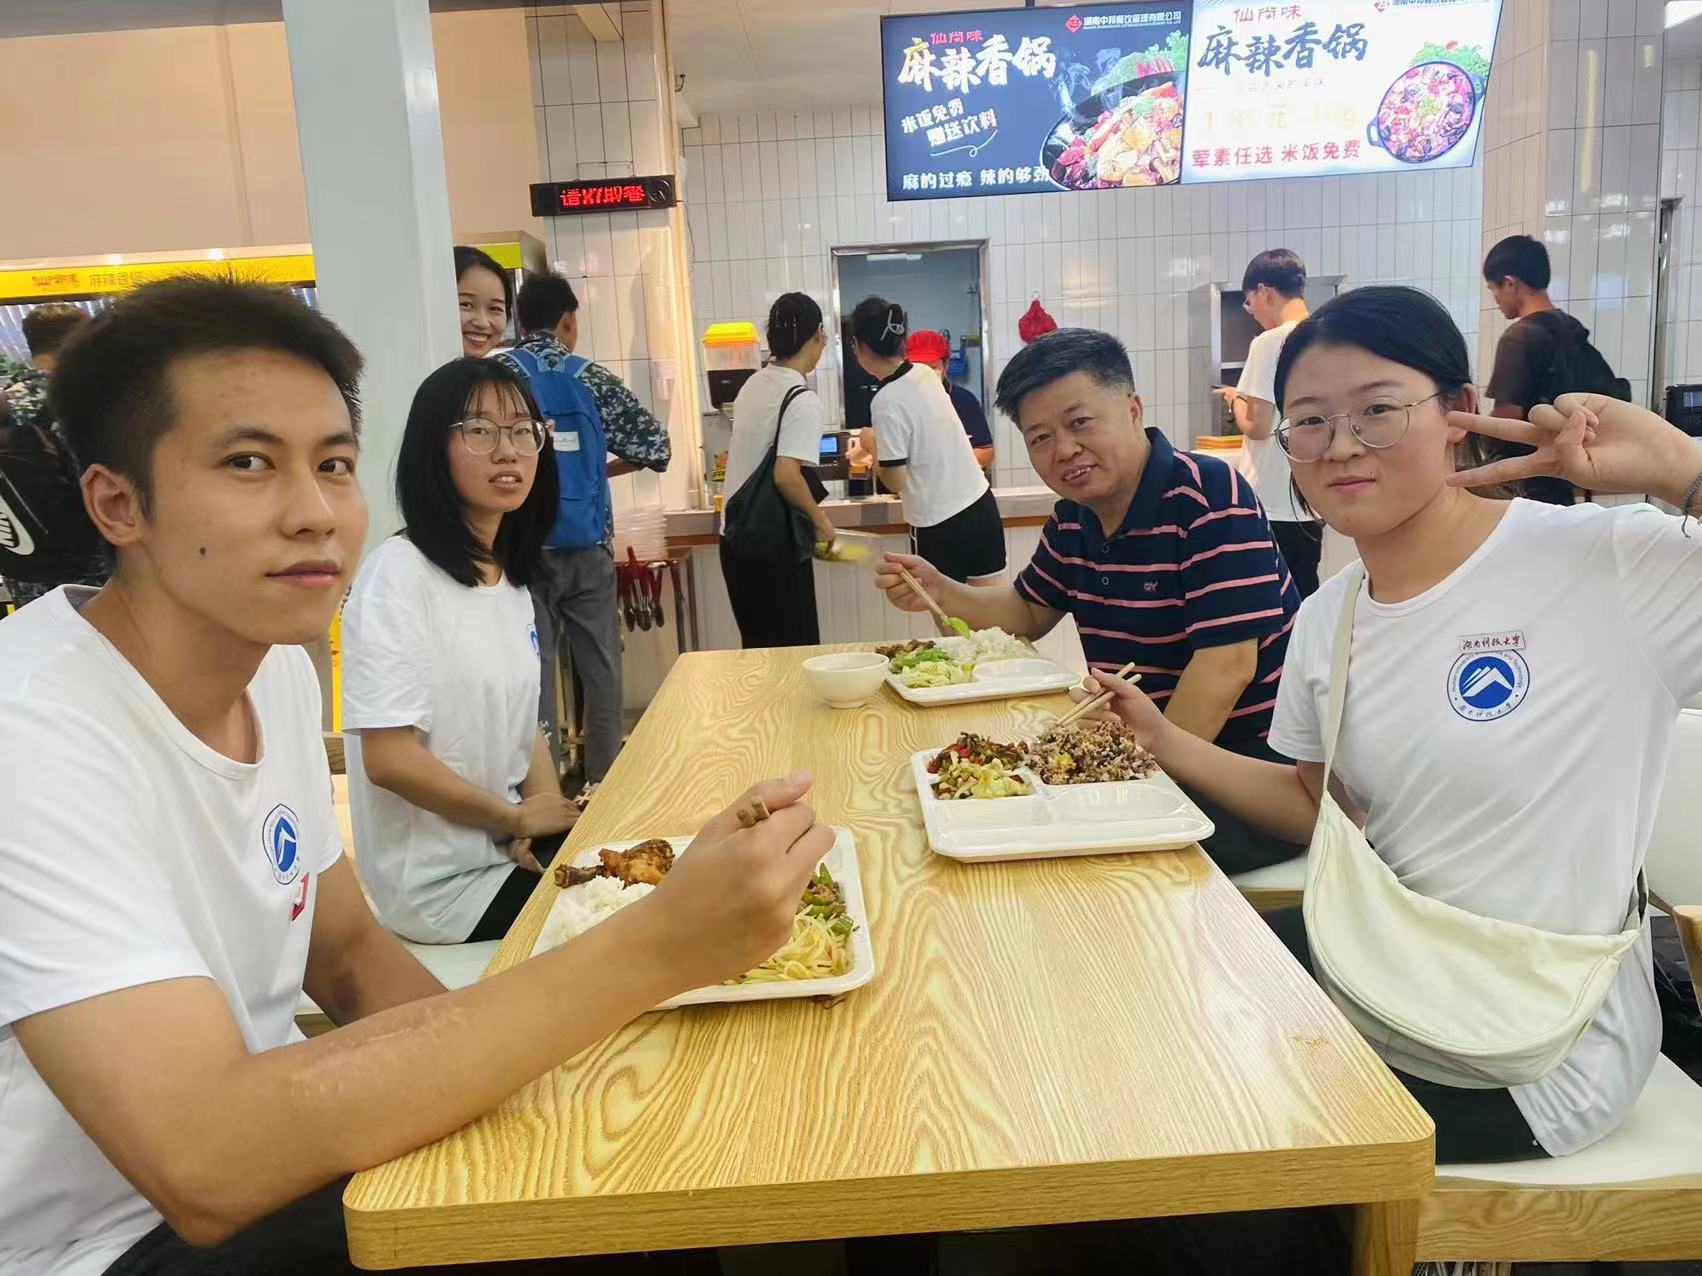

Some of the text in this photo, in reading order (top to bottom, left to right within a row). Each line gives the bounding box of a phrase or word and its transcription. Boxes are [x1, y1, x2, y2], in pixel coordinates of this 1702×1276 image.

[897, 34, 1056, 93] 麻辣香锅
[1197, 22, 1368, 77] 麻辣香锅
[1192, 139, 1361, 167] 荤素任选 米饭免费
[902, 171, 973, 190] 麻的过瘾
